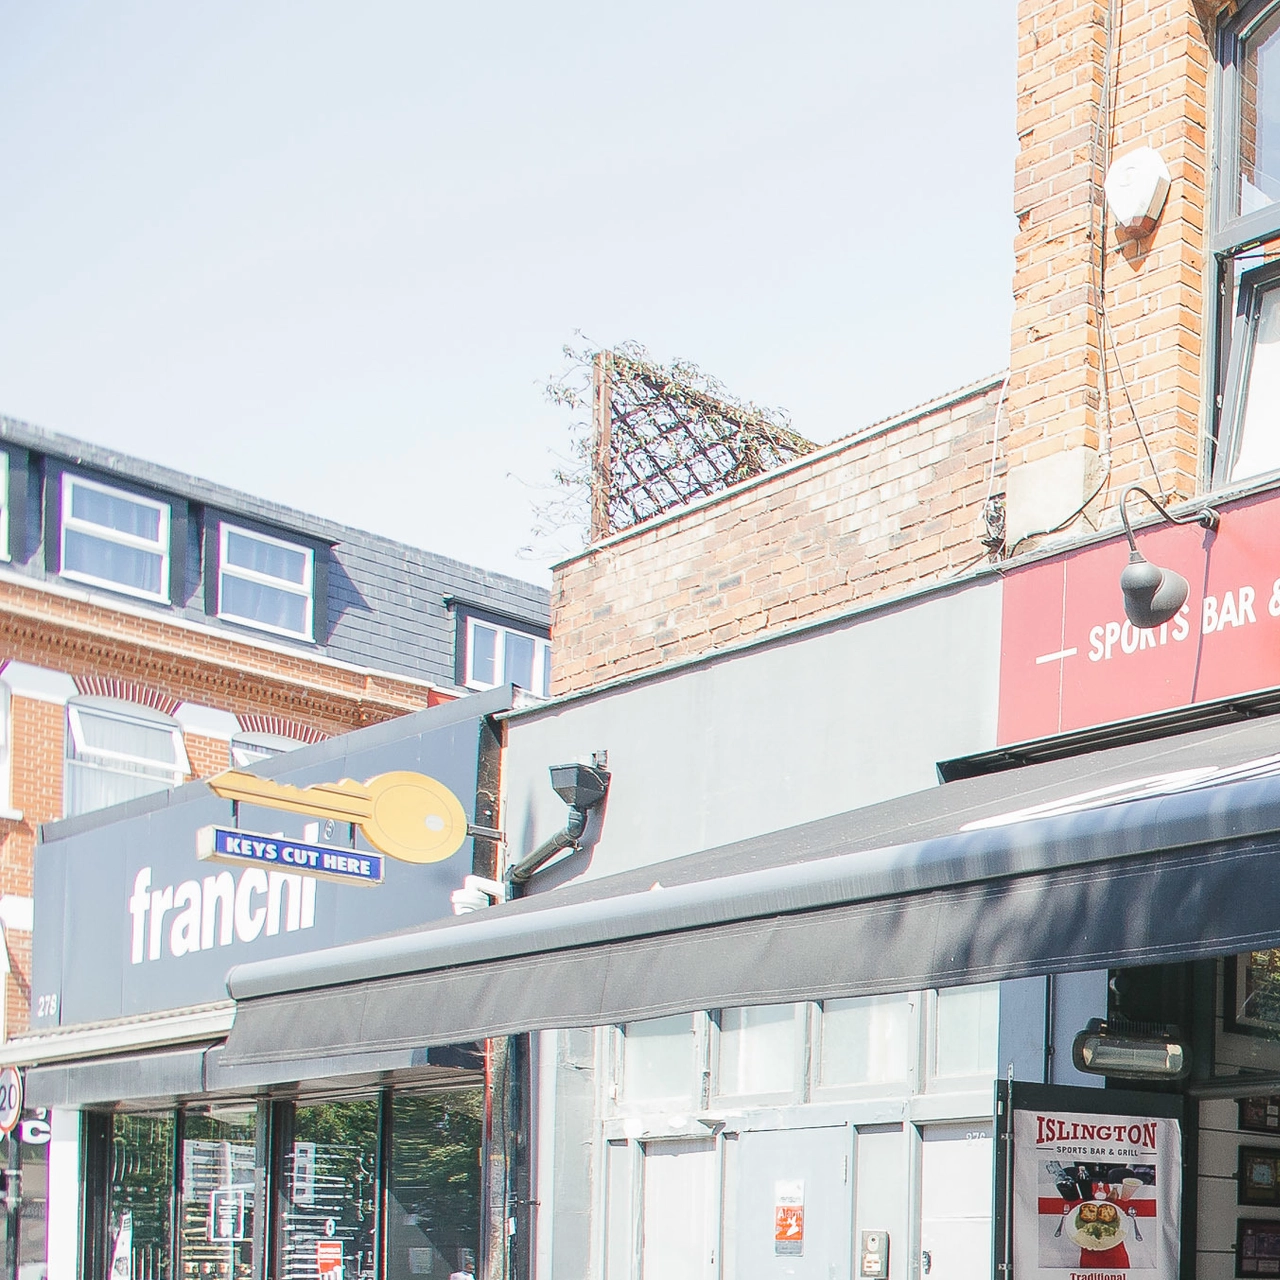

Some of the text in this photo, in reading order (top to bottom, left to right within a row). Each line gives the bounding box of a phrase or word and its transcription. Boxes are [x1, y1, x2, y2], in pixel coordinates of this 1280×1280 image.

[1202, 586, 1257, 635] BAR
[225, 836, 371, 876] KEYS CUT HERE
[37, 993, 58, 1018] 278
[1036, 1115, 1157, 1149] ISLINGTON
[1057, 1146, 1087, 1154] SPORTS
[1090, 1147, 1106, 1155] BAR
[1117, 1149, 1138, 1157] GRILL
